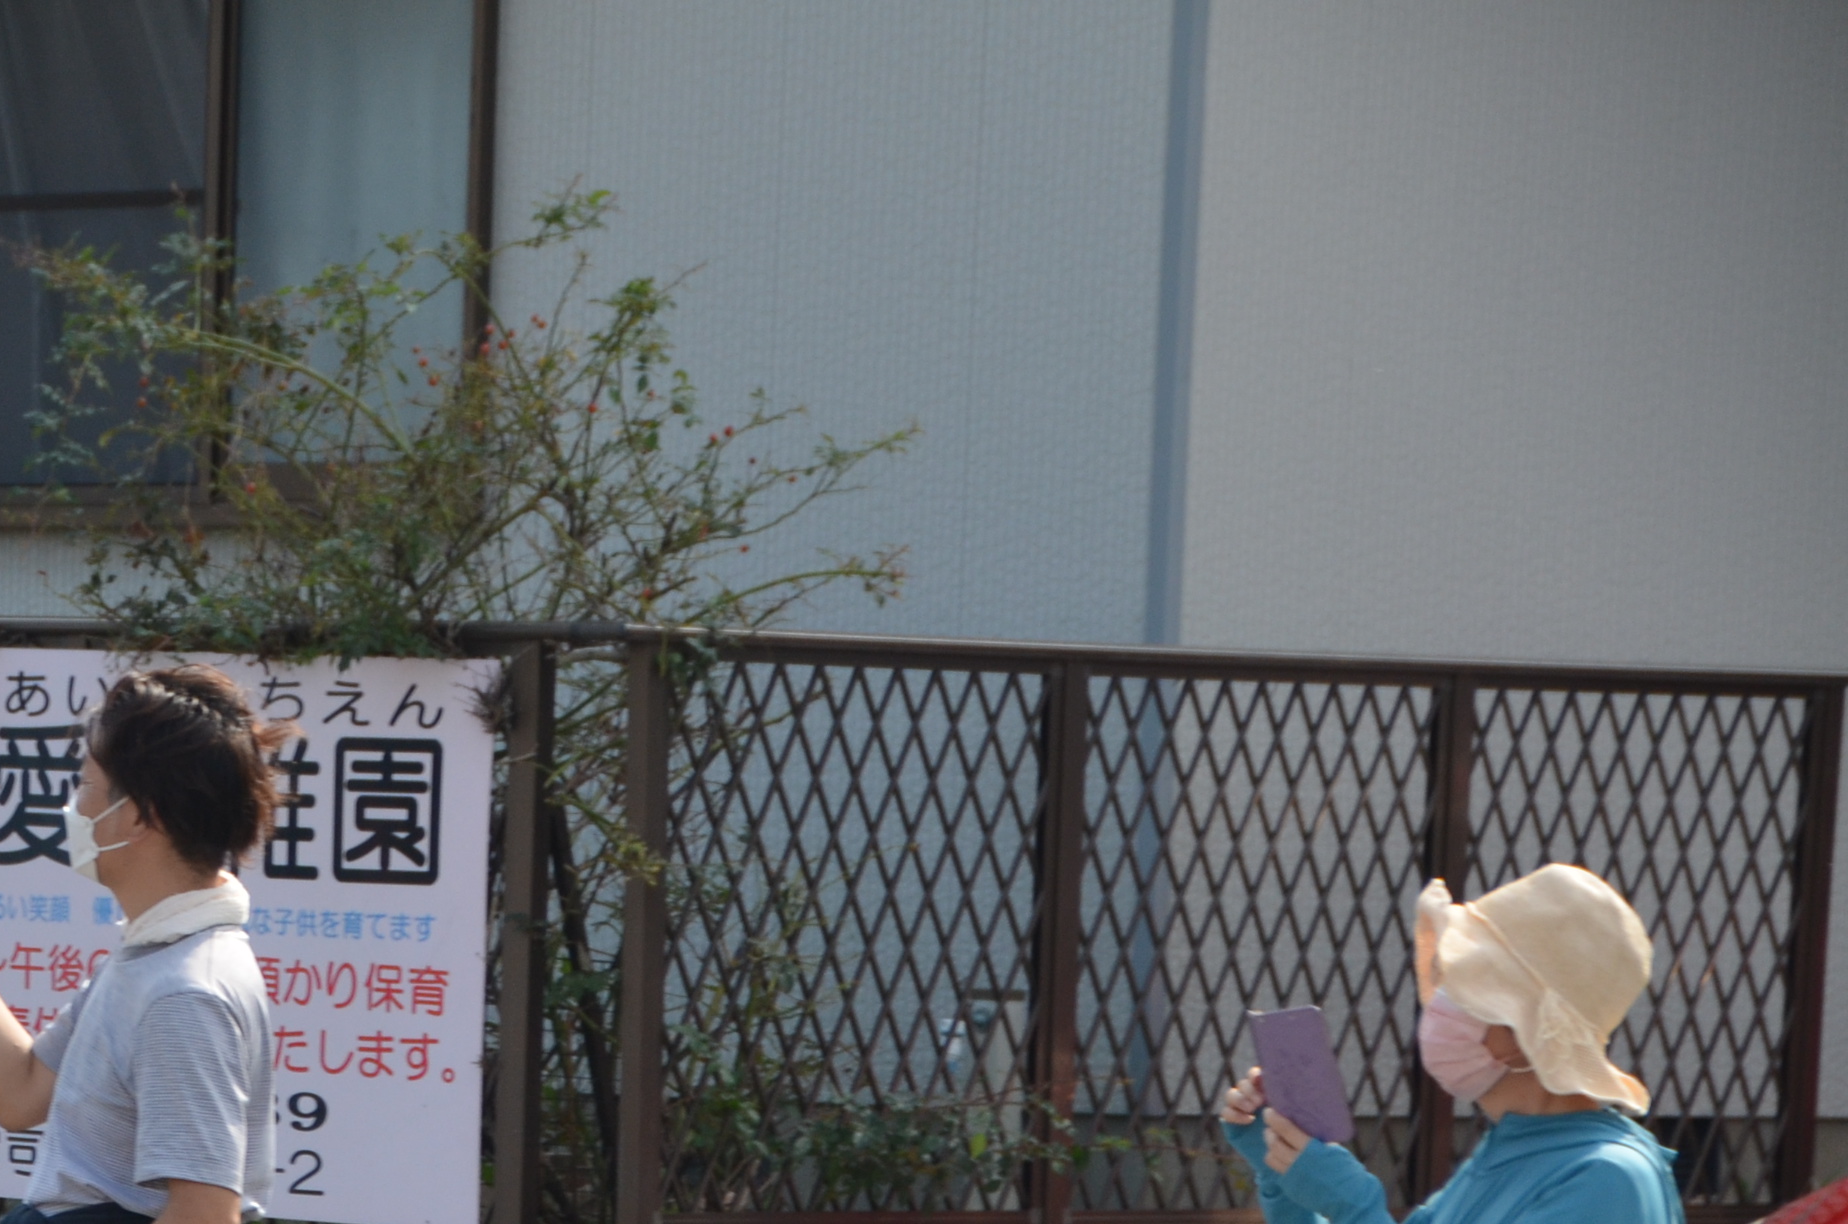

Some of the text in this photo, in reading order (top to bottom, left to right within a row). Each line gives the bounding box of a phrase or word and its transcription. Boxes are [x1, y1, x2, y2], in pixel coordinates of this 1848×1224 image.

[243, 907, 437, 942] な子供を育てます
